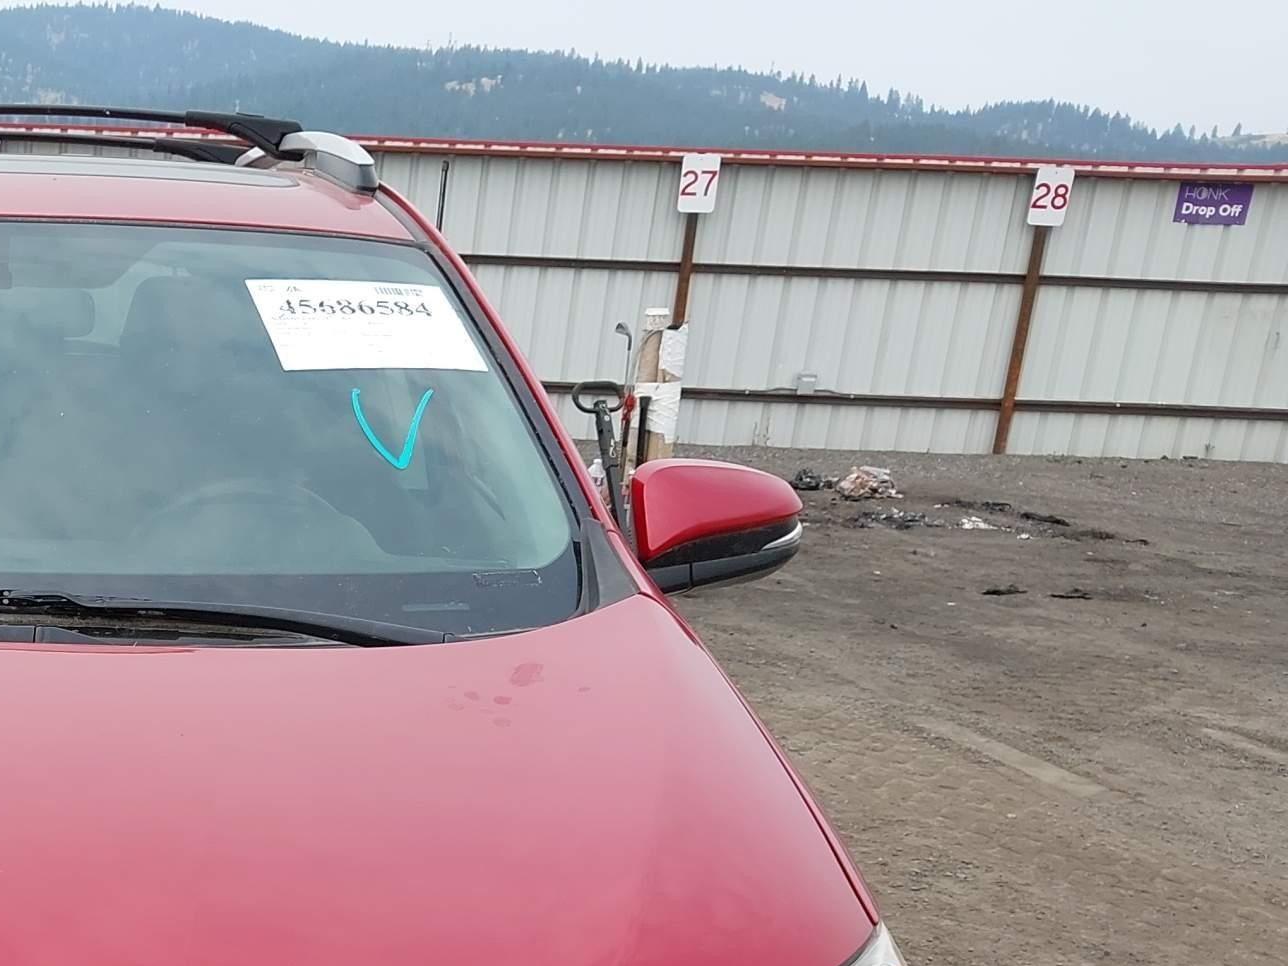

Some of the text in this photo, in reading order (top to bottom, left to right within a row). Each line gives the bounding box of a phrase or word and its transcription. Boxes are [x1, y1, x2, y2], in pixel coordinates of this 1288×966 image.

[680, 170, 718, 197] 27
[1031, 183, 1069, 210] 28
[1184, 186, 1231, 201] HONK
[1181, 202, 1243, 218] Drop Off
[279, 299, 432, 317] 45686584
